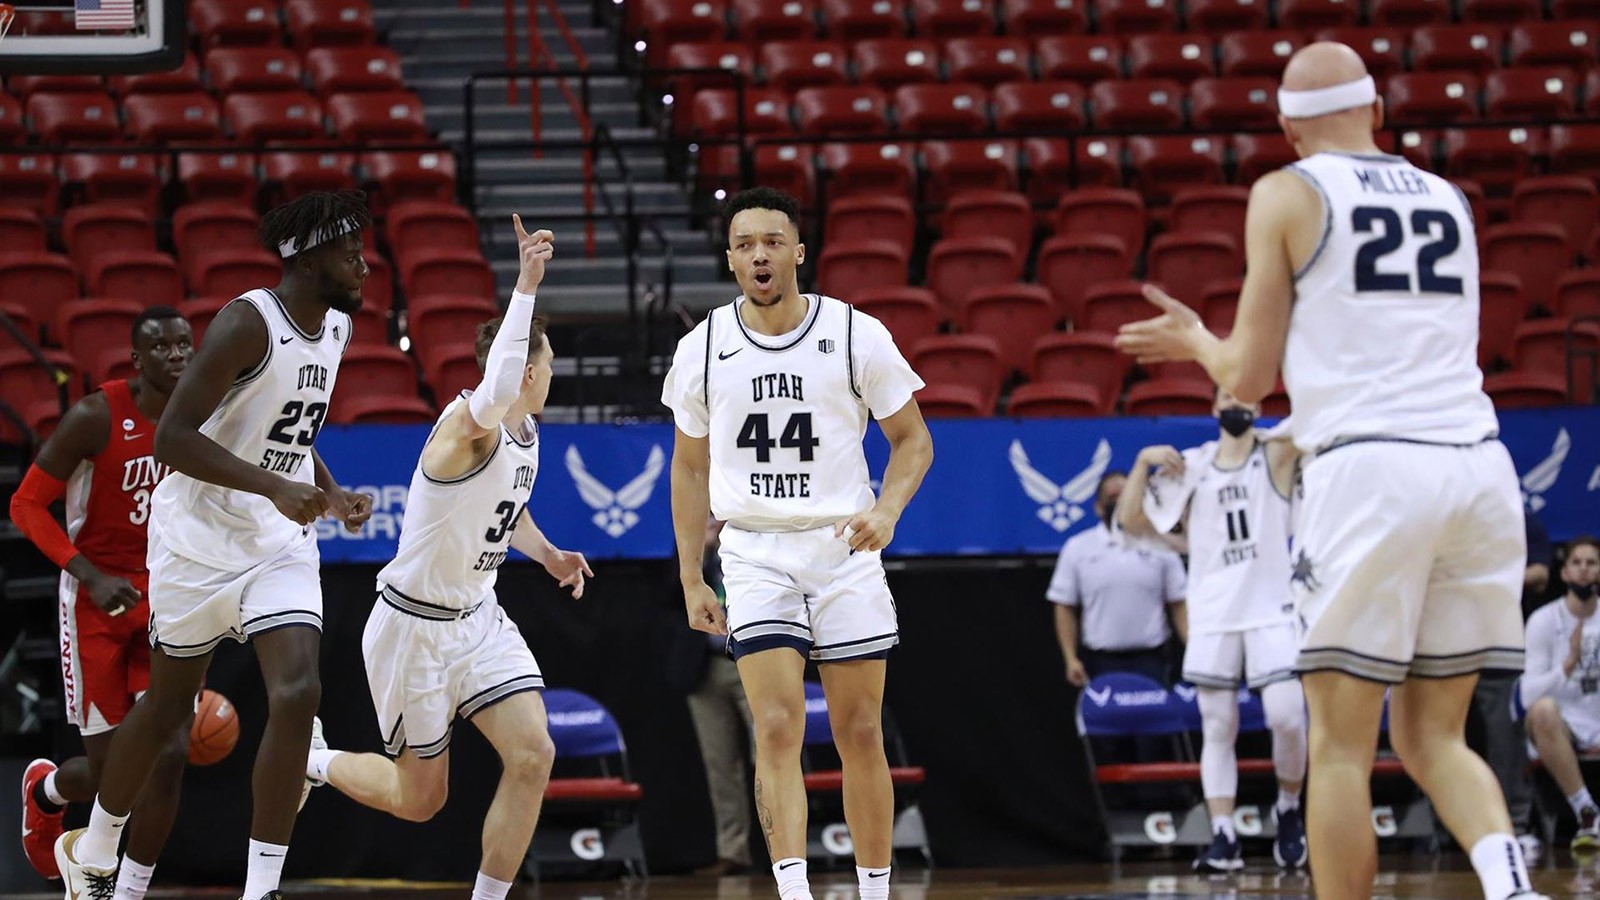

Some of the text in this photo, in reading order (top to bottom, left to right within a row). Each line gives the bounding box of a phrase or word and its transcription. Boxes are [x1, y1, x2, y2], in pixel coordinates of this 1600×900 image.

[1353, 168, 1431, 195] MILLER
[1351, 205, 1464, 295] 22
[297, 364, 328, 392] UTAH
[751, 373, 804, 403] UTAH
[266, 400, 327, 447] 23
[736, 412, 820, 463] 44
[750, 473, 810, 498] STATE
[1226, 508, 1250, 542] 11
